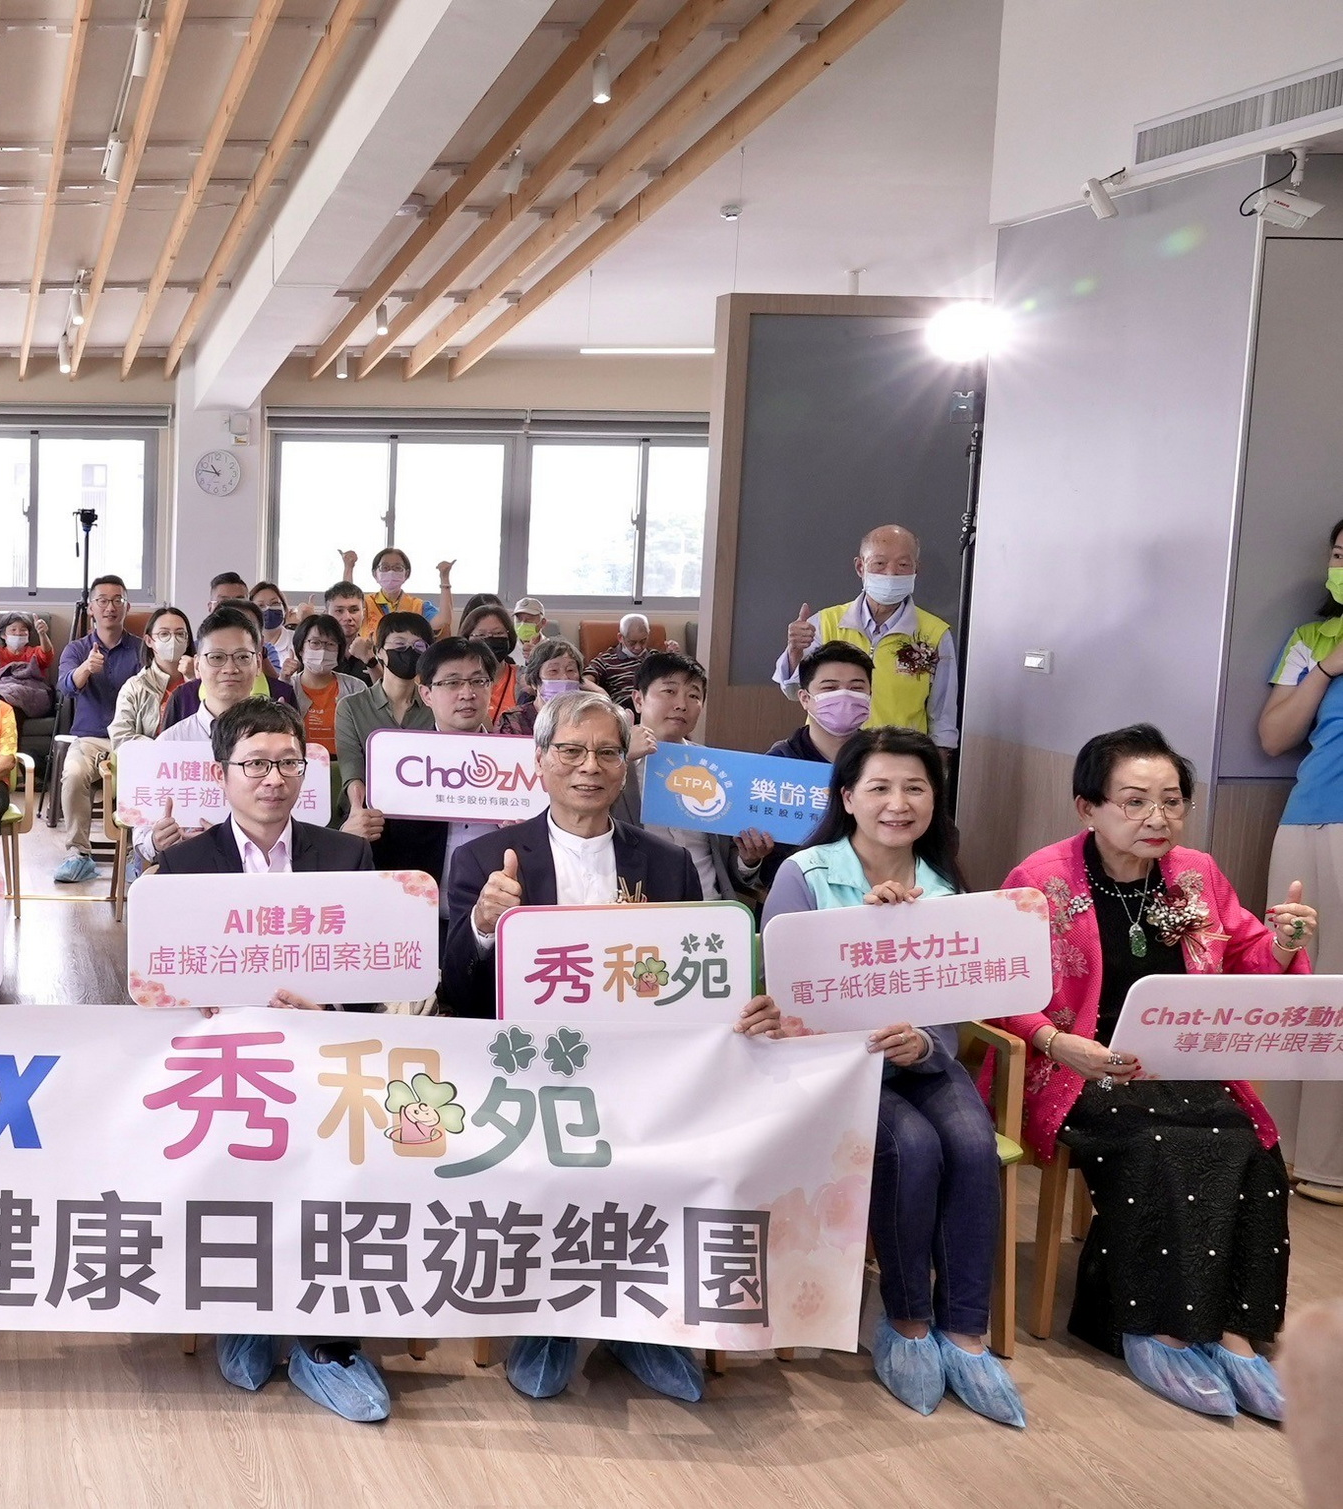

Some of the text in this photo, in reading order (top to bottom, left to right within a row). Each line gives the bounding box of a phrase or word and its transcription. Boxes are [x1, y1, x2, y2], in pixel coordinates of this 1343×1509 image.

[435, 793, 530, 807] 集仕多股份有限公司
[673, 776, 713, 791] LTPA
[749, 777, 831, 811] 樂齡智
[223, 904, 347, 936] AI健身房
[146, 940, 423, 977] 虛擬治療師個案追蹤
[839, 930, 980, 969] 「我是大力士」
[790, 956, 1031, 1006] 電子紙復能手拉環輔具
